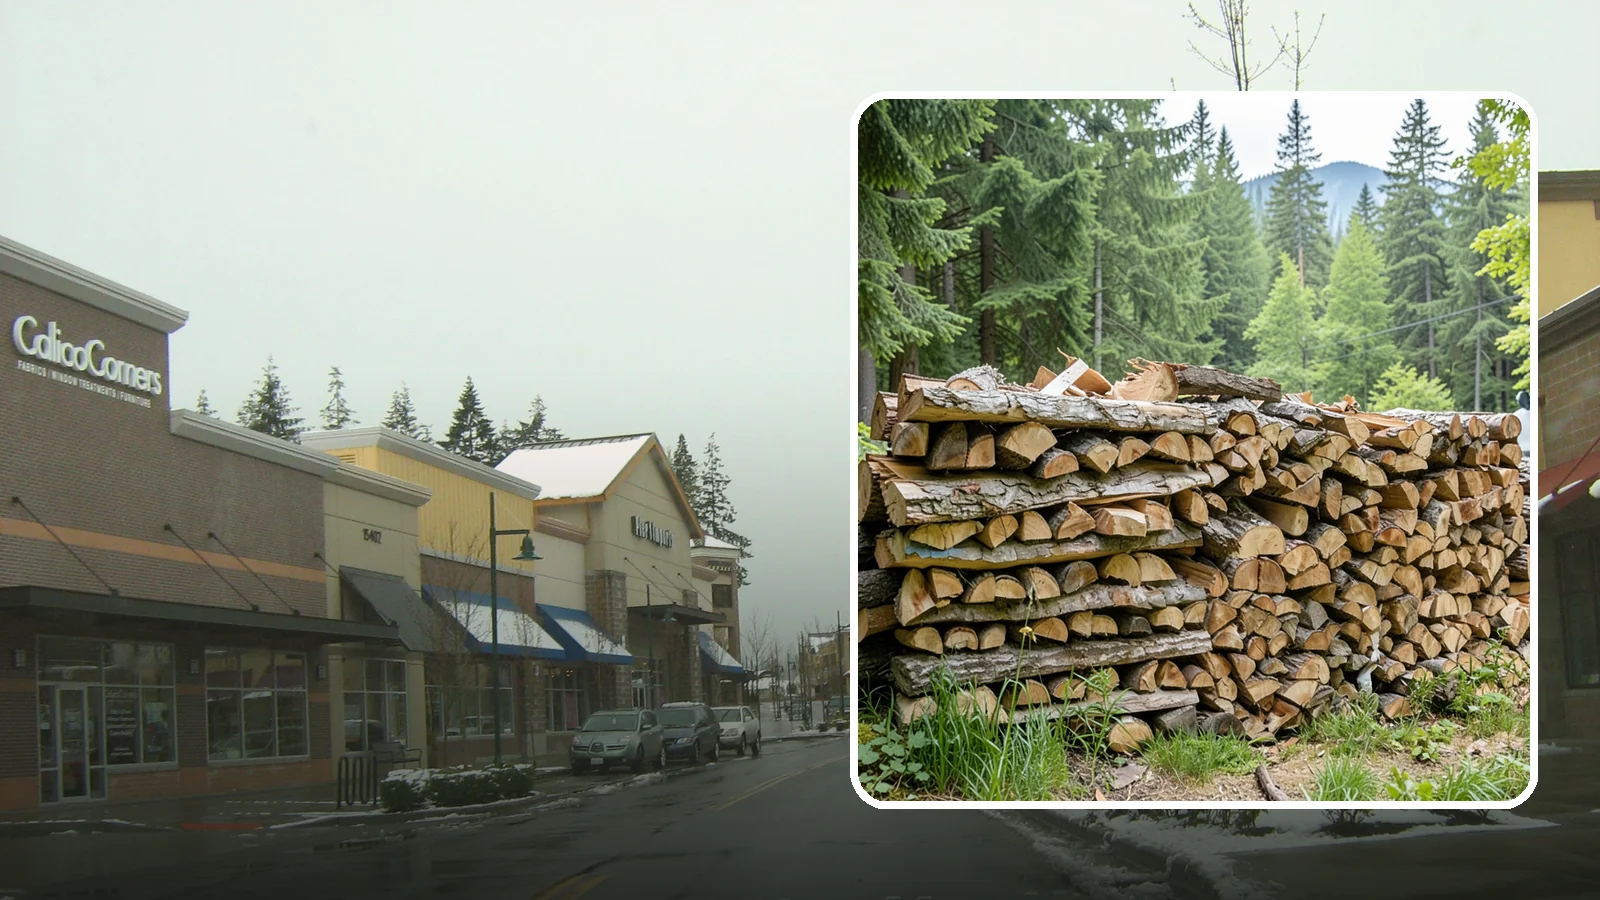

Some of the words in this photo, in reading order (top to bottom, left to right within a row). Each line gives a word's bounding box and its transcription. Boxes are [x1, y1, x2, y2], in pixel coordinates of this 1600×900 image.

[17, 359, 47, 378] FABRICS
[51, 370, 78, 387] WINDOW
[79, 378, 117, 398] TREATMENTS
